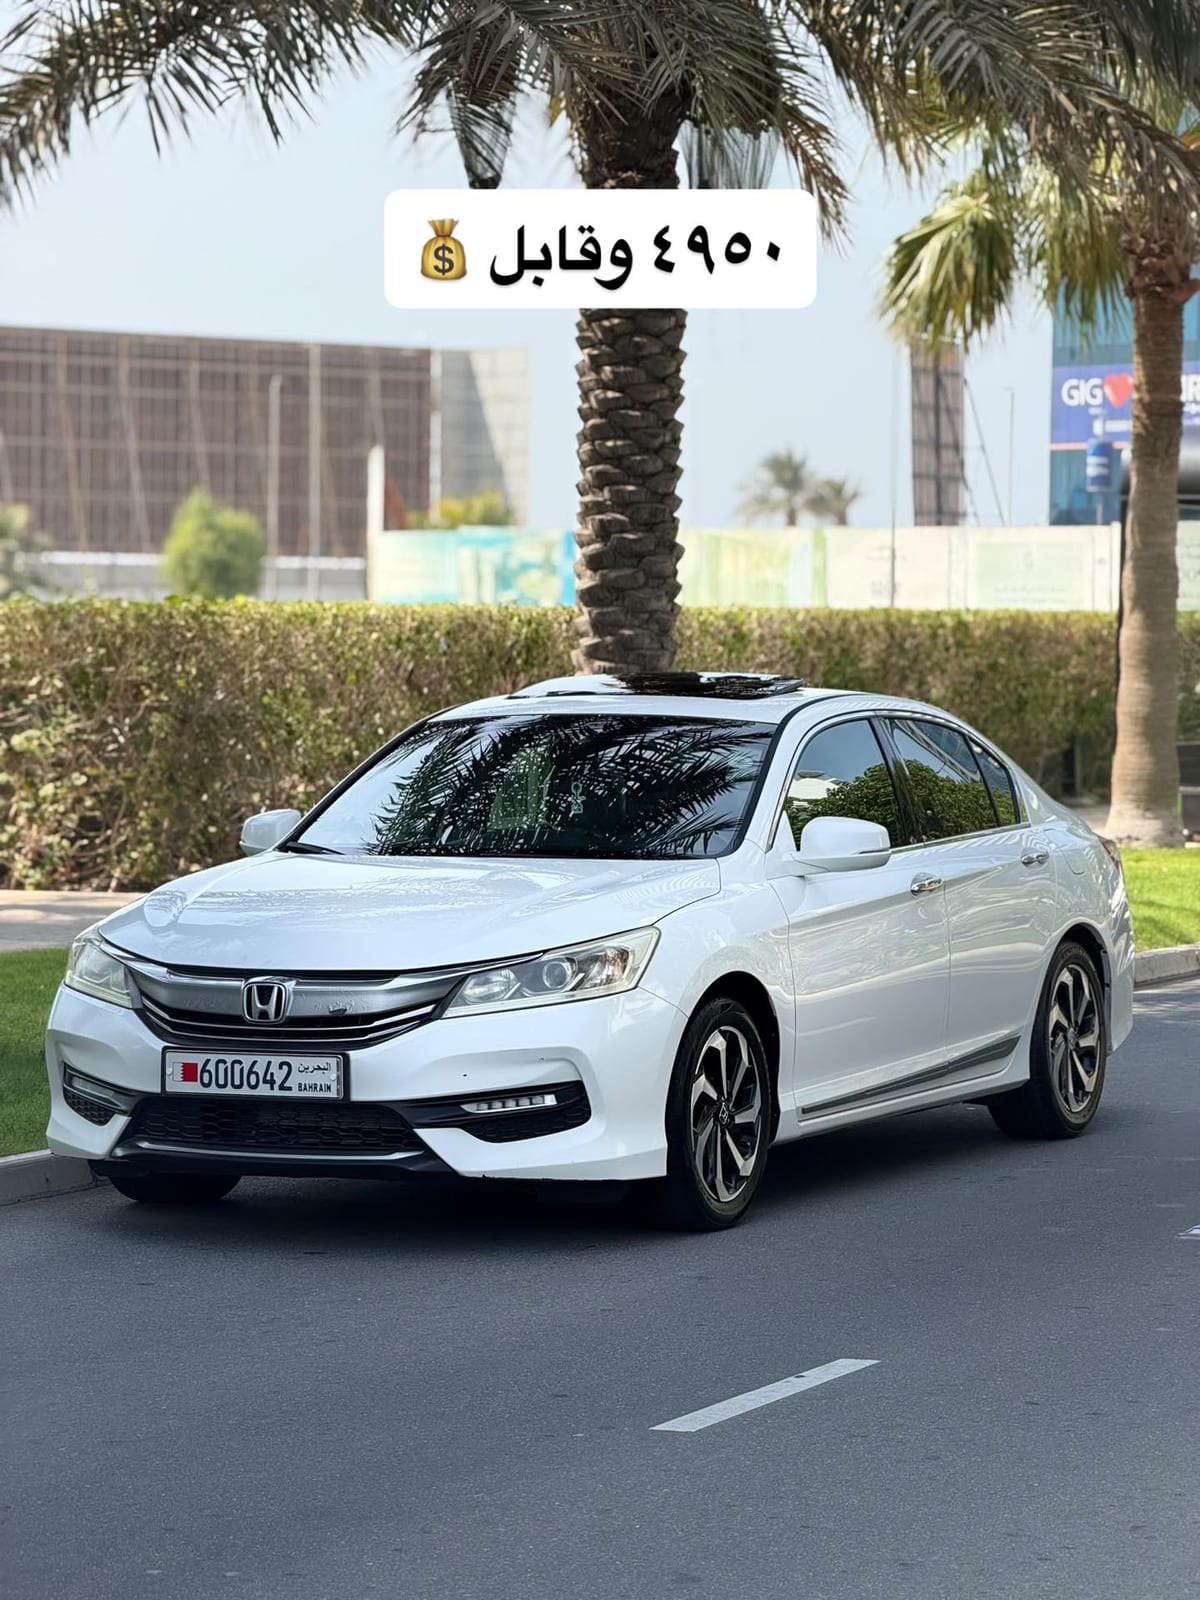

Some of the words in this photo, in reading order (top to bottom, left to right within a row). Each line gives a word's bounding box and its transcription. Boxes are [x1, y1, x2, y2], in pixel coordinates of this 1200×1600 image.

[1061, 377, 1104, 407] GIG
[199, 1058, 293, 1092] 600642
[298, 1061, 331, 1074] البحرين
[298, 1082, 332, 1092] BAHRAIN
